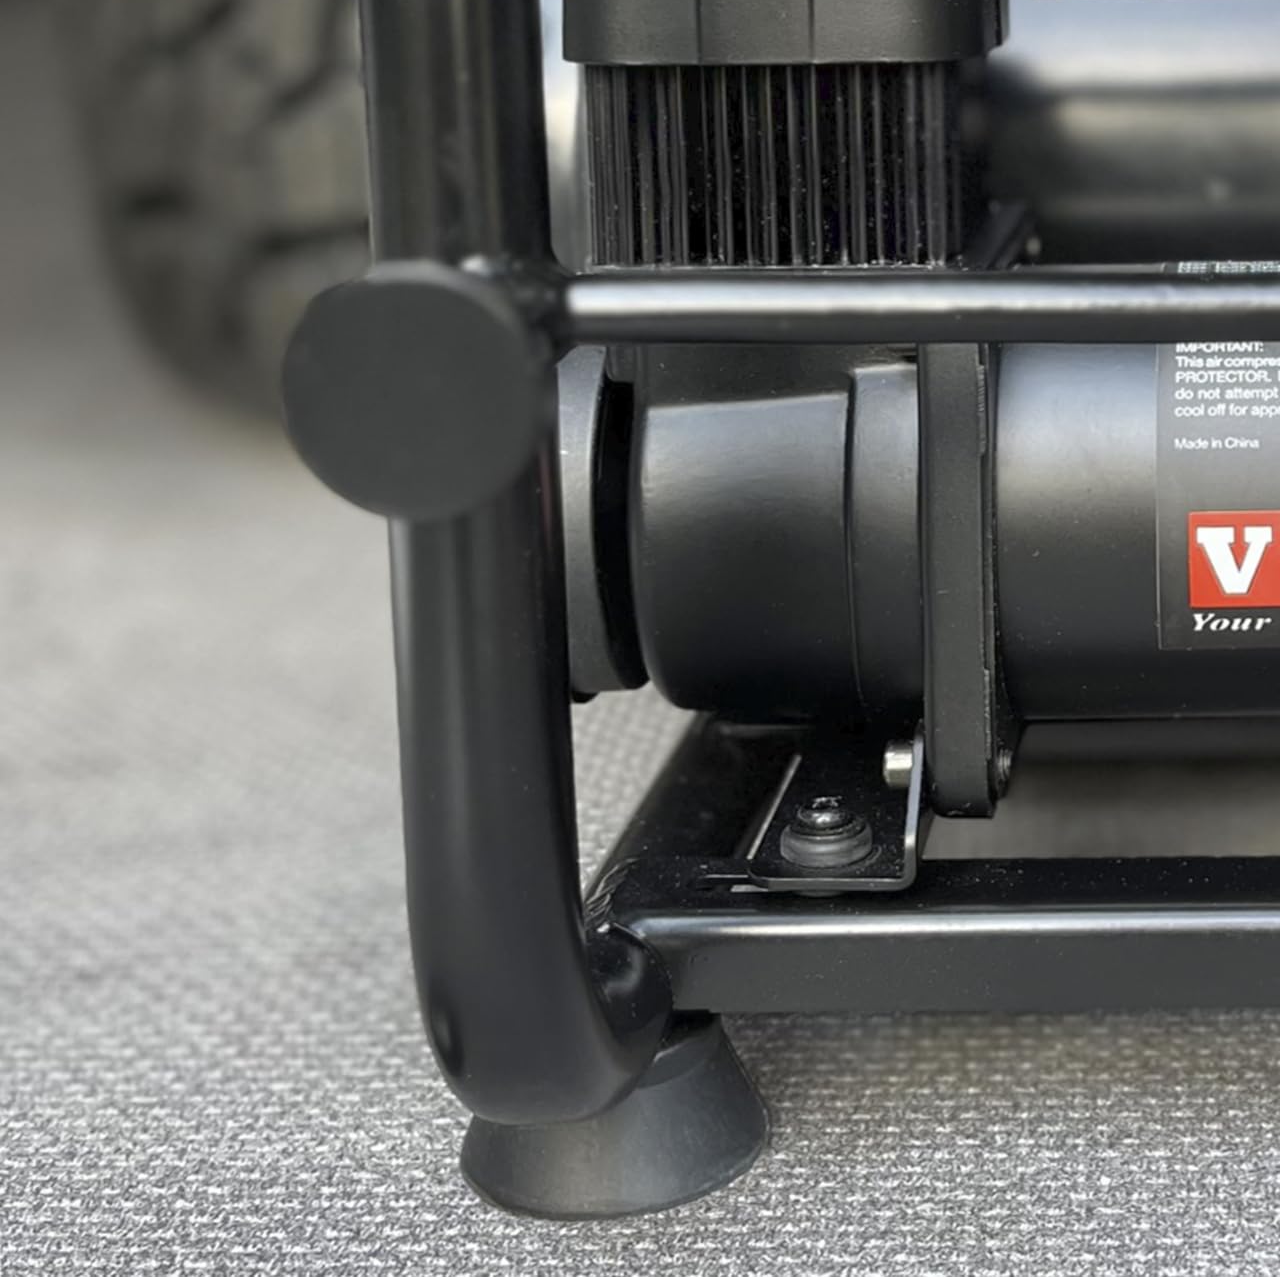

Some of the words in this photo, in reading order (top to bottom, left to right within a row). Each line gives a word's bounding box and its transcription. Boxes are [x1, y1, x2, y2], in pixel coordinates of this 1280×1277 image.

[1176, 356, 1203, 368] This
[1206, 356, 1222, 367] air
[1175, 371, 1272, 383] PROTECTOR.
[1174, 387, 1193, 399] do
[1197, 387, 1220, 399] not
[1225, 386, 1278, 401] attempt
[1174, 404, 1204, 417] cool
[1207, 404, 1225, 416] off
[1229, 404, 1248, 416] for
[1174, 438, 1208, 449] Made
[1211, 437, 1222, 449] in
[1224, 437, 1260, 449] China
[1192, 612, 1272, 631] Your
